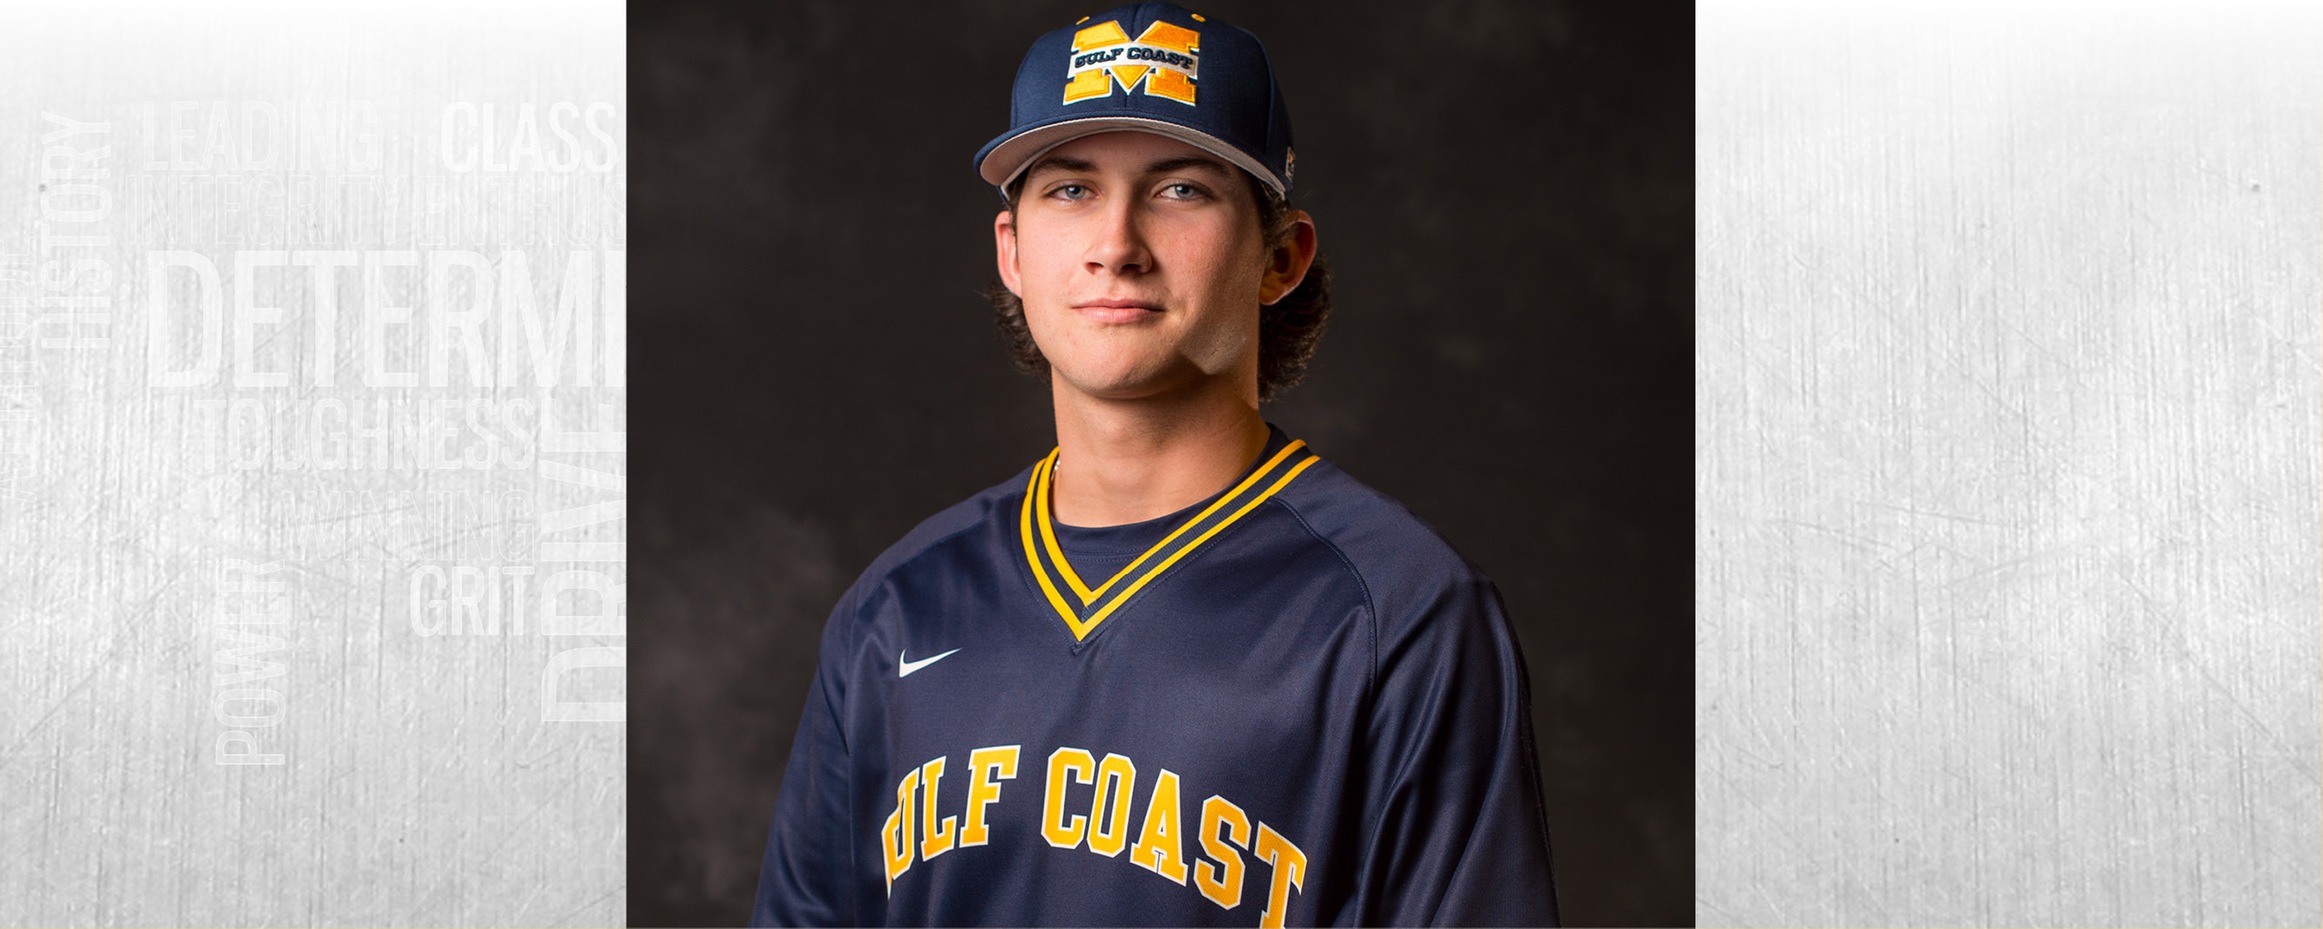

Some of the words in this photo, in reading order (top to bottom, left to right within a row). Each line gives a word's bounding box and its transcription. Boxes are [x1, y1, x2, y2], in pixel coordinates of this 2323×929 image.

[1075, 48, 1124, 68] GULF
[1126, 47, 1193, 70] COAST
[1041, 746, 1308, 928] COAST
